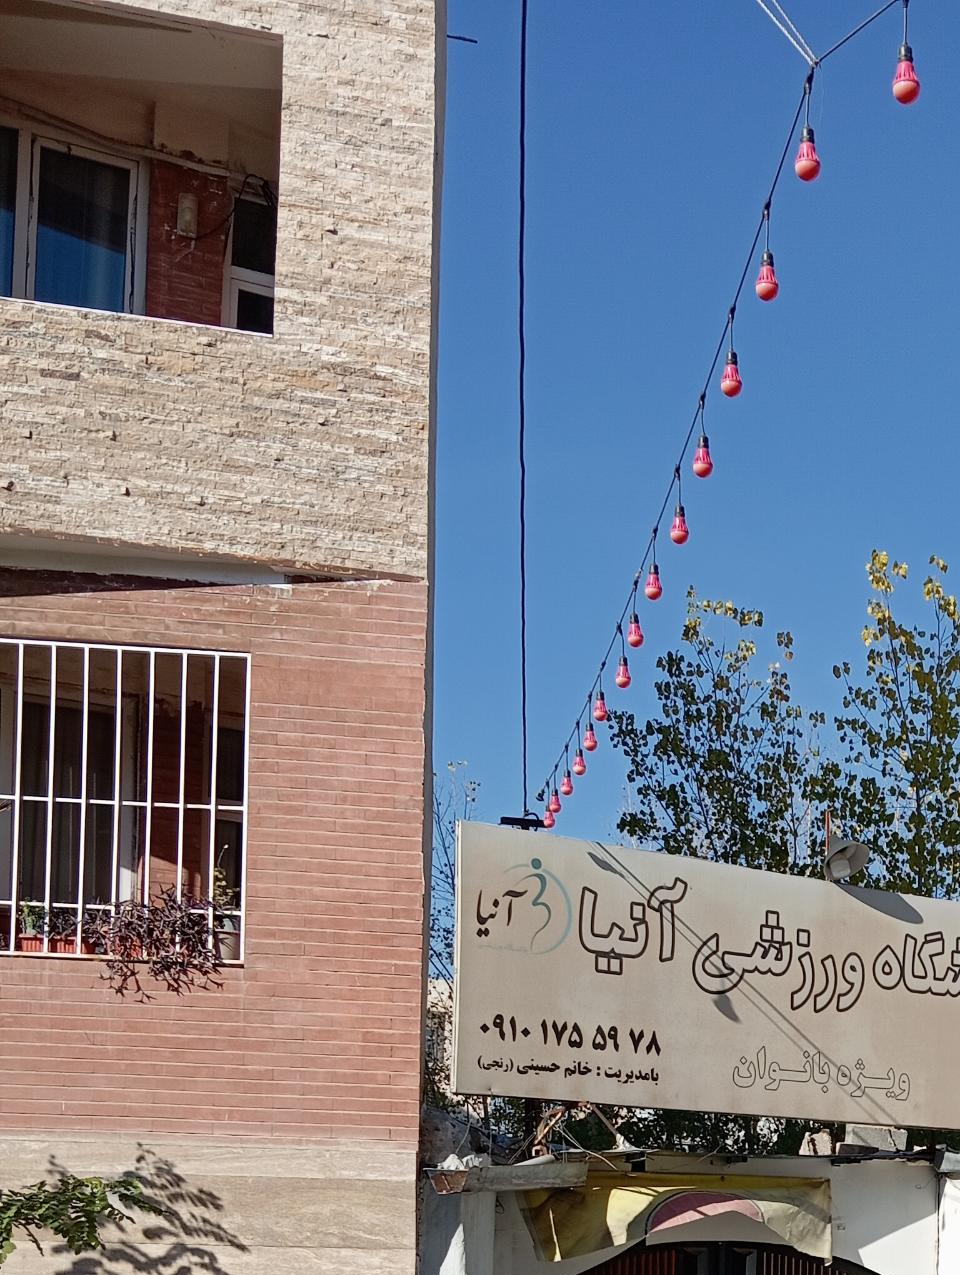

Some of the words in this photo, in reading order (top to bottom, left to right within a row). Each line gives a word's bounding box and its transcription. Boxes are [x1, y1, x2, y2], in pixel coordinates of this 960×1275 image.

[476, 889, 528, 937] آنیا
[579, 877, 688, 976] آنیا
[692, 910, 865, 1013] ورزشی
[516, 1058, 560, 1075] حسینی
[564, 1061, 592, 1078] خانم
[732, 1045, 831, 1094] بانوان
[836, 1058, 911, 1101] ویژه
